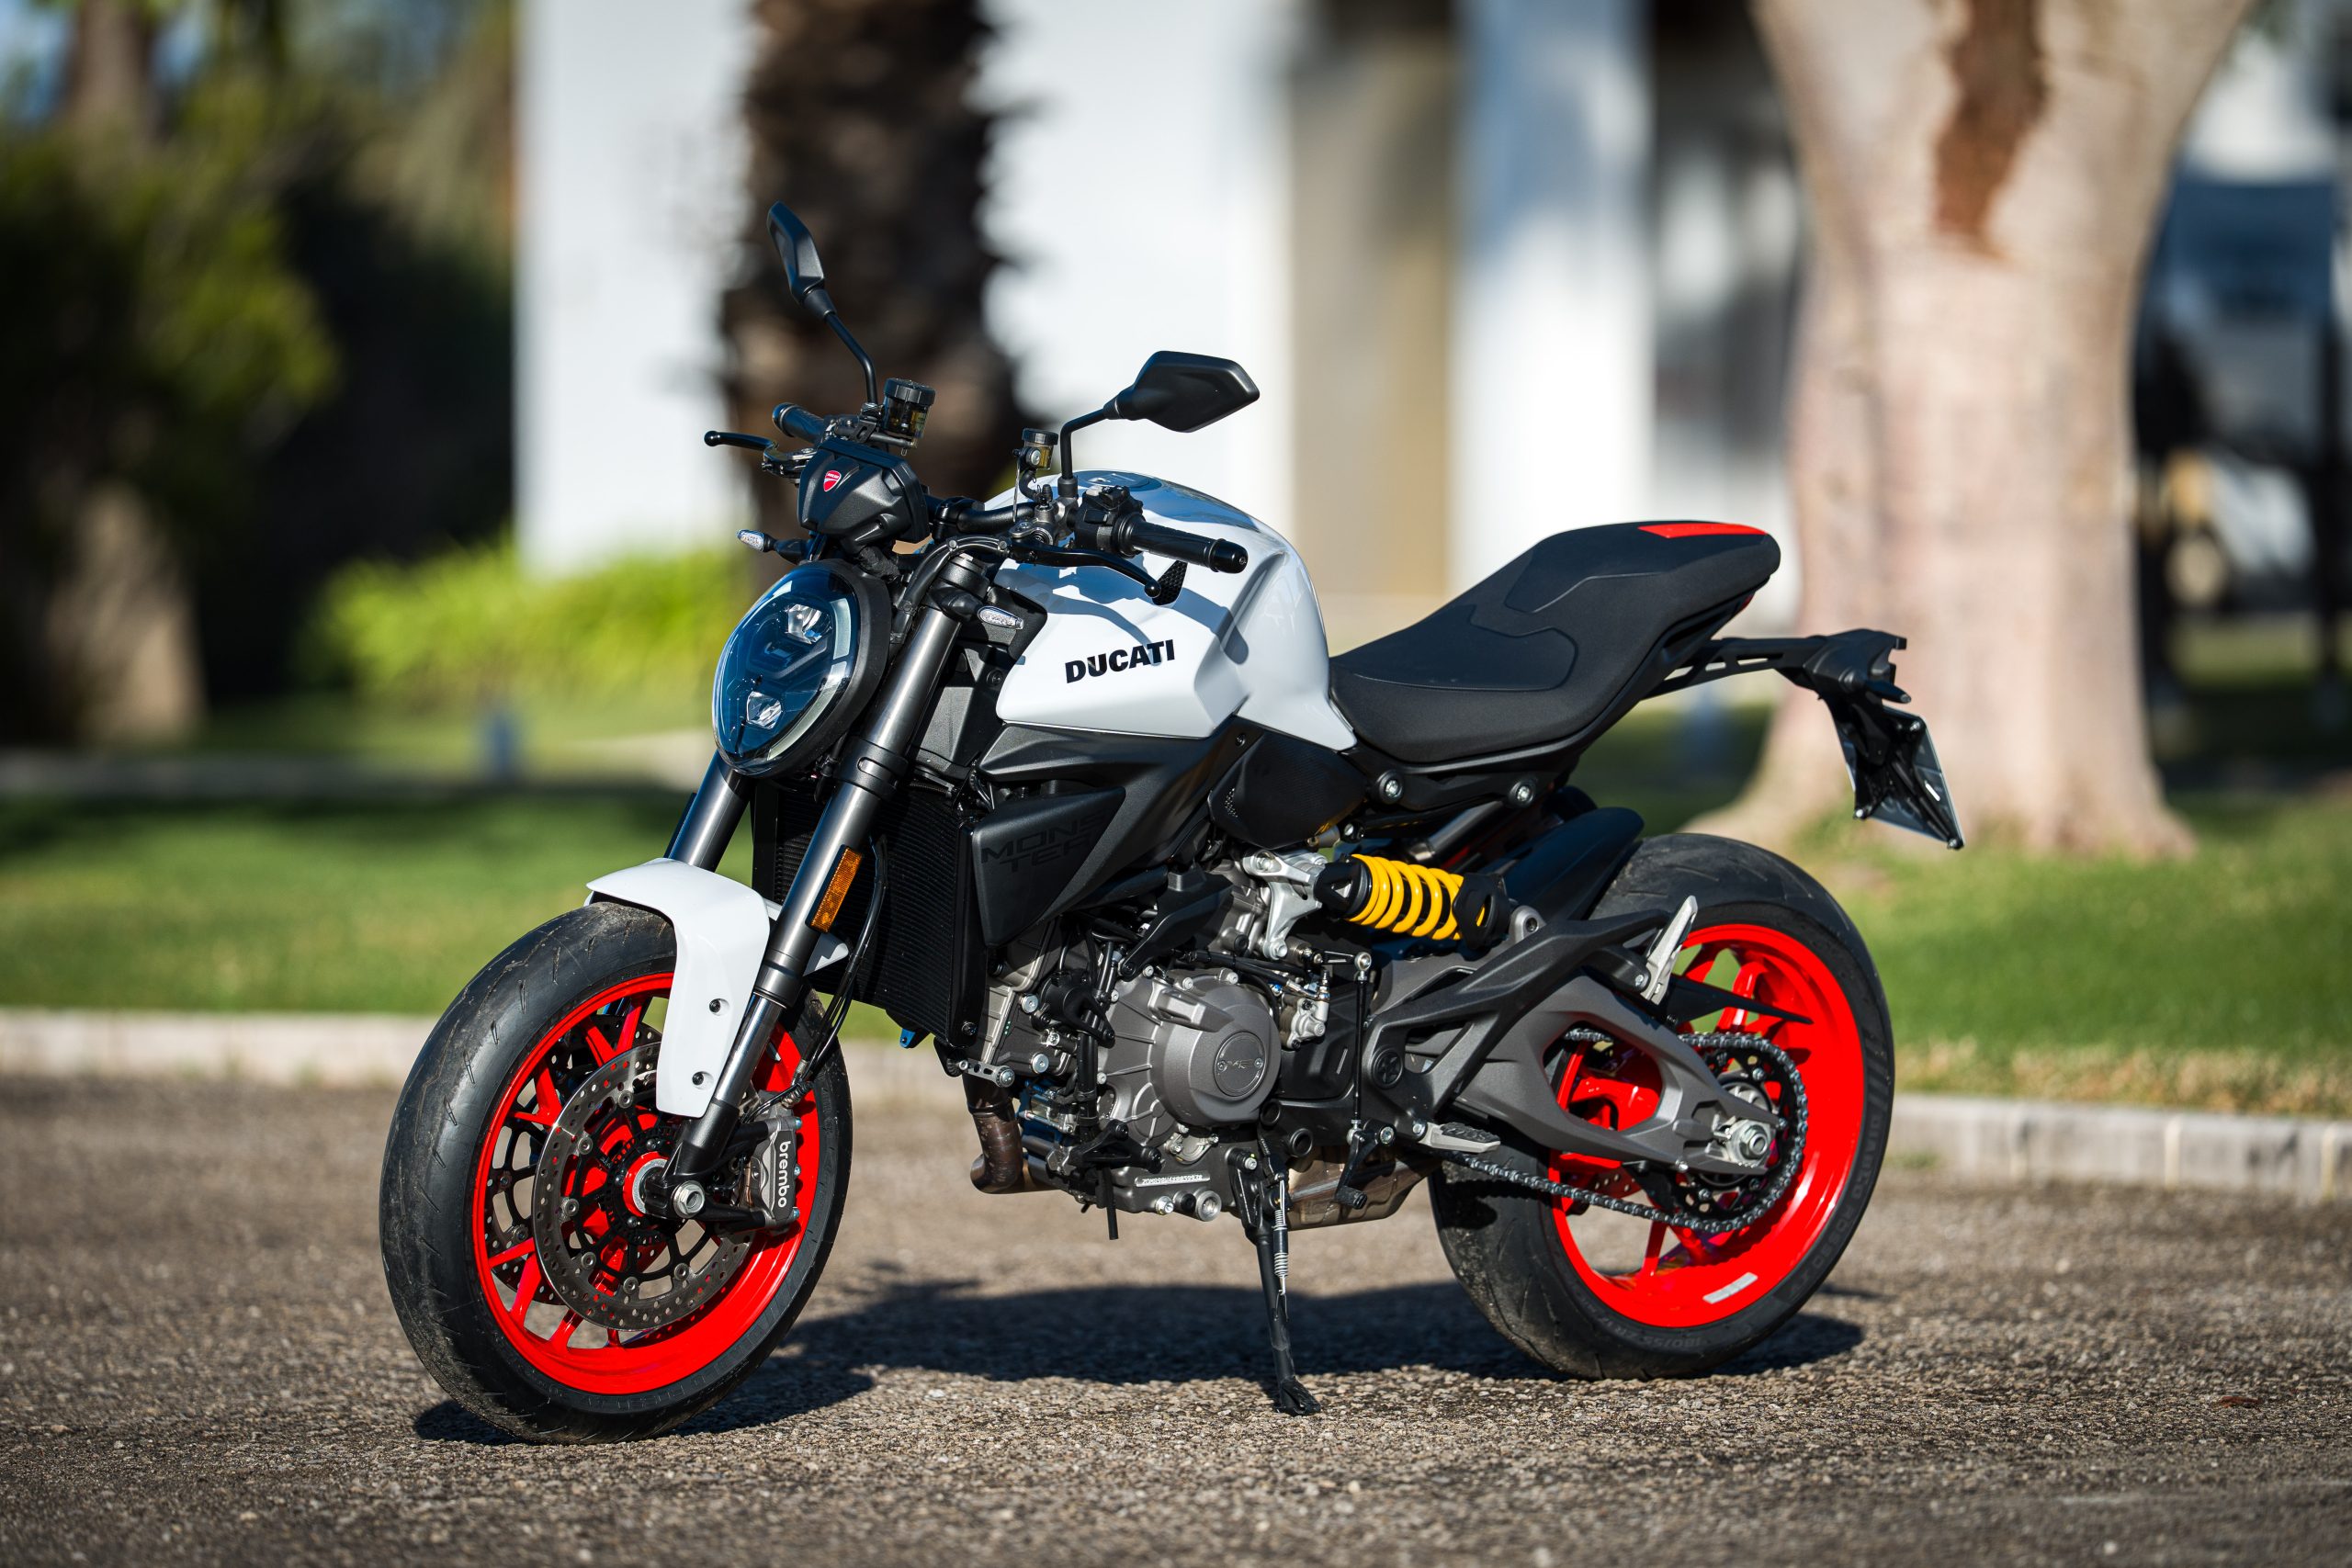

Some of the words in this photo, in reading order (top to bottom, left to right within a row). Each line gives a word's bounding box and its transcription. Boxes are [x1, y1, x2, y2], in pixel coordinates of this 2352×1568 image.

[1064, 638, 1175, 683] DUCATI
[981, 809, 1104, 864] MONS
[777, 1140, 792, 1208] brembo
